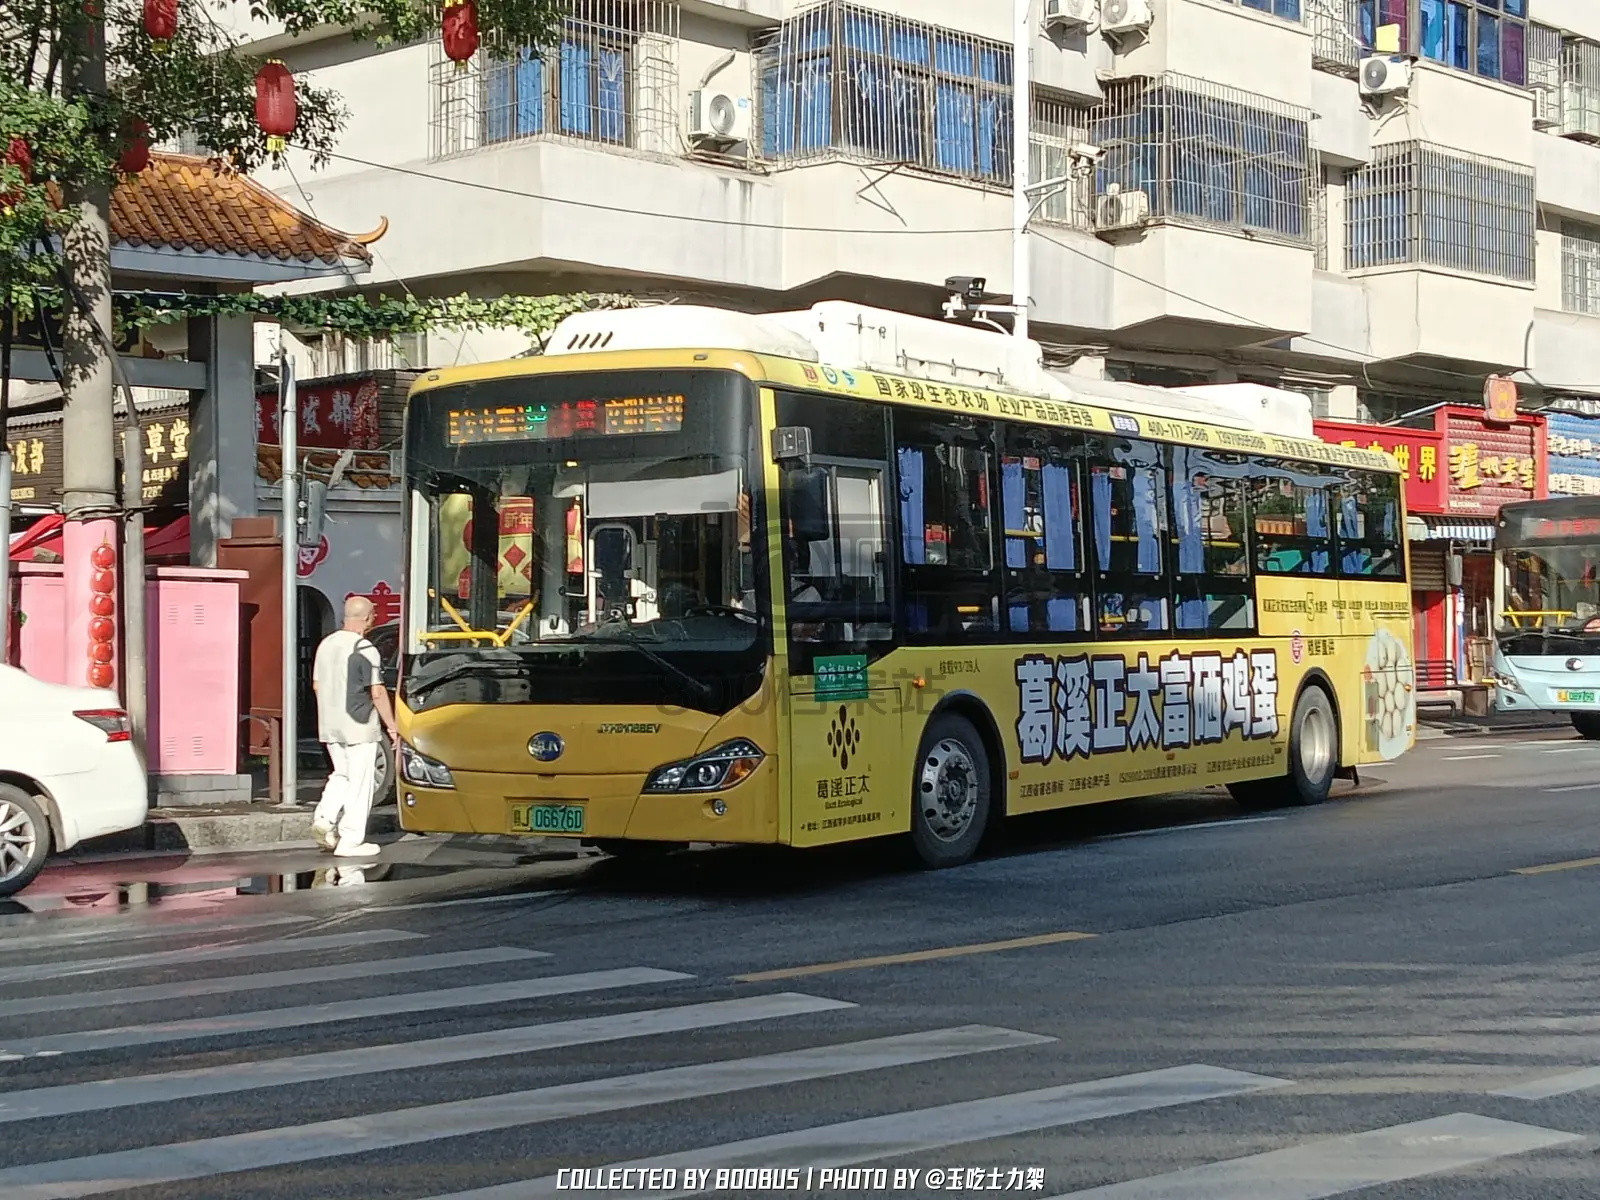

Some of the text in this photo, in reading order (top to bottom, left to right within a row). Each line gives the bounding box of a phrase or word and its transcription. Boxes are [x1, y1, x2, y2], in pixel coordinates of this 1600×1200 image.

[872, 374, 990, 411] 国家级生态农场
[503, 511, 533, 529] 新年
[1014, 647, 1280, 766] 葛溪正太富硒鸡蛋
[816, 774, 871, 799] 葛溪正太
